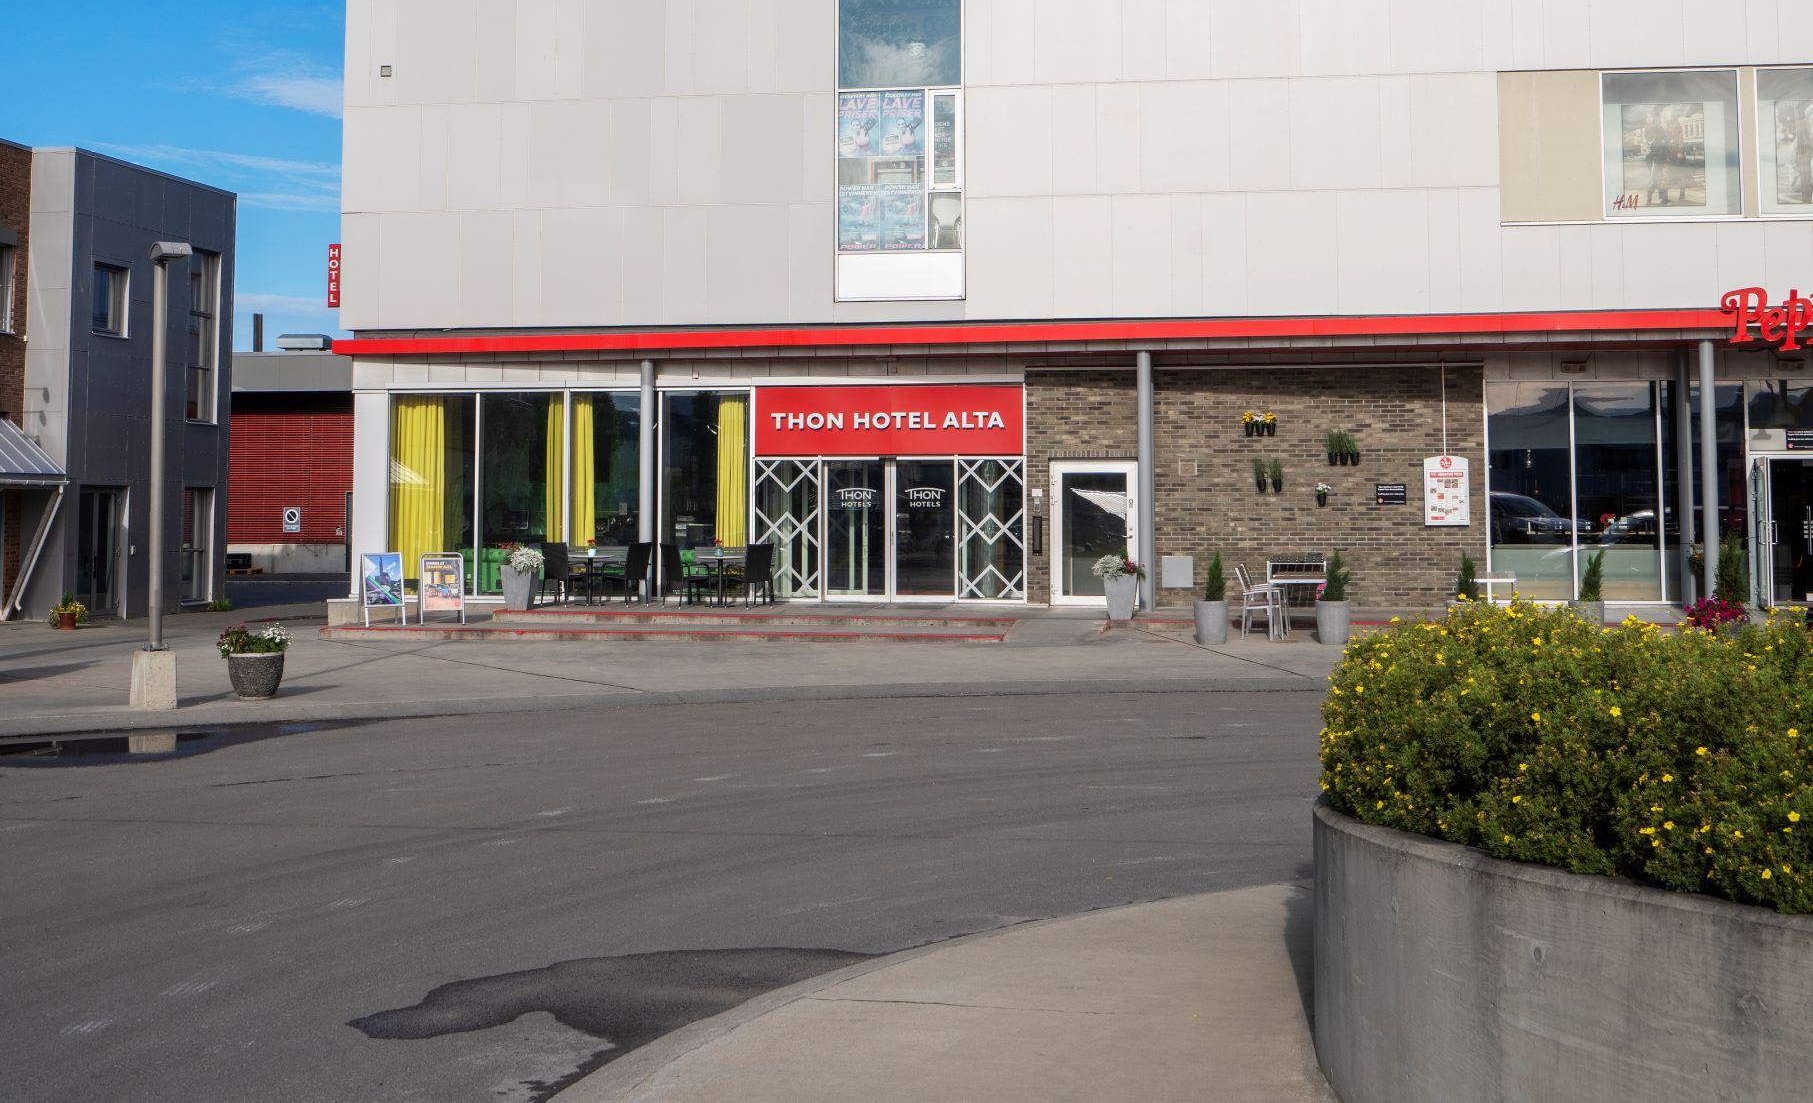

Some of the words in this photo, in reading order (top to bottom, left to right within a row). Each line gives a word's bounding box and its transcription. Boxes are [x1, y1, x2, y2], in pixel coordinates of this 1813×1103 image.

[839, 98, 877, 111] LAVE
[882, 97, 923, 110] LAVE
[839, 110, 878, 119] PRISER
[882, 109, 922, 118] PRISER
[1612, 193, 1639, 210] H&M
[329, 248, 339, 303] HOTEL
[1720, 286, 1813, 352] Pep
[771, 412, 844, 430] THON
[854, 412, 936, 430] HOTEL
[942, 411, 1005, 429] ALTA
[836, 487, 877, 500] THON
[905, 487, 946, 500] THON
